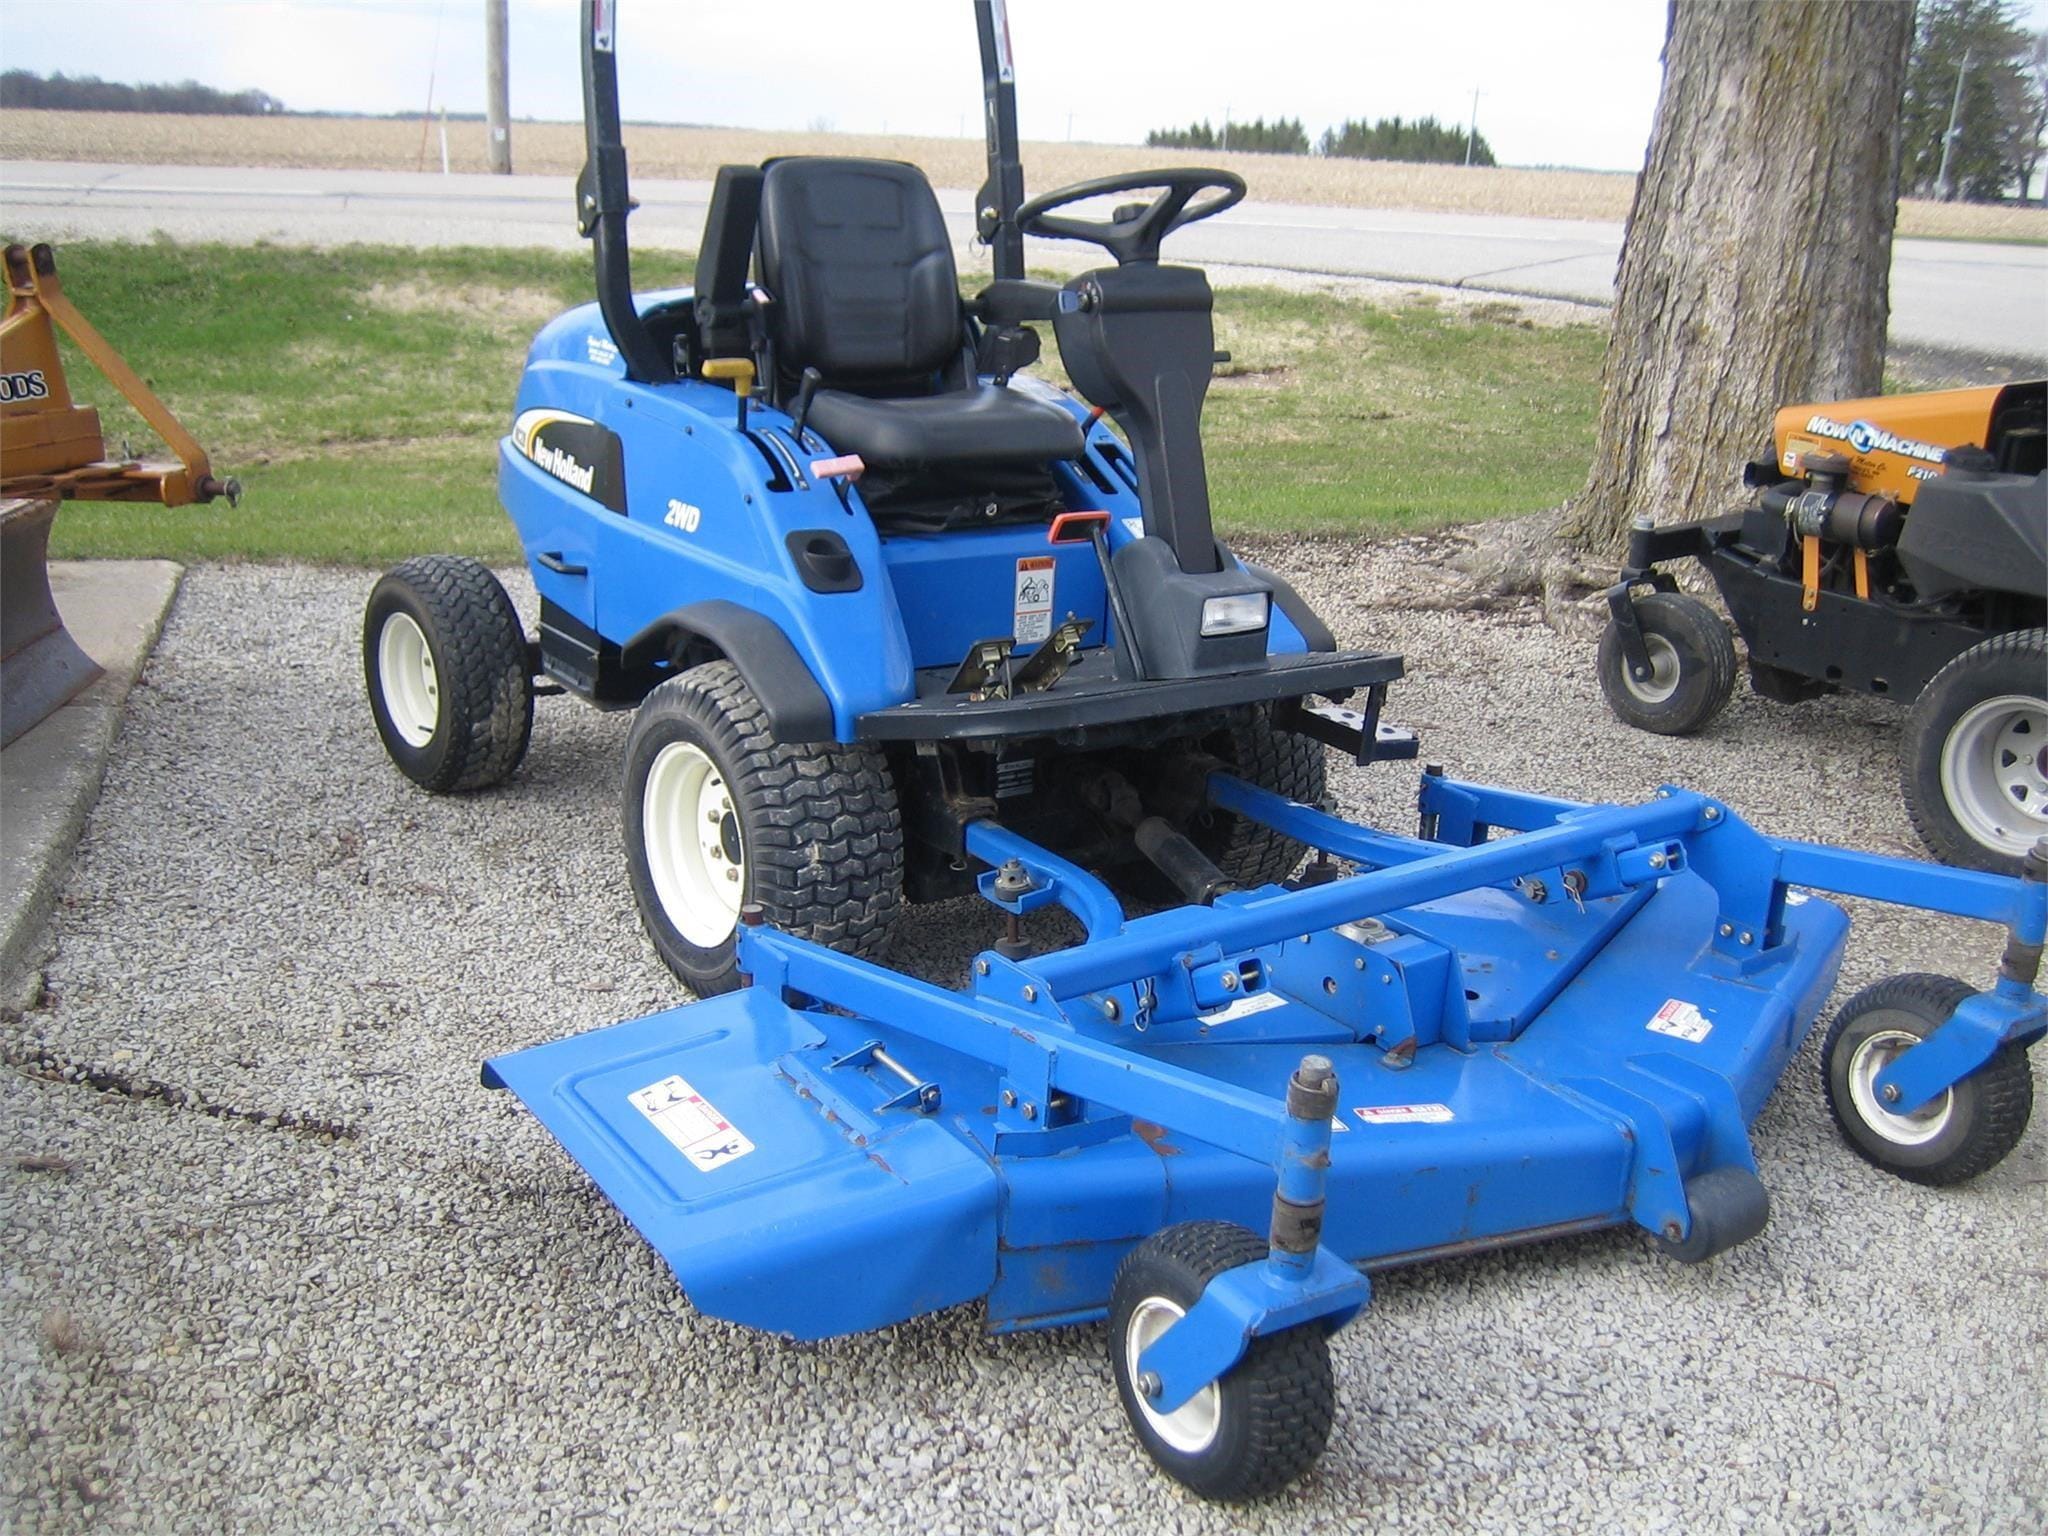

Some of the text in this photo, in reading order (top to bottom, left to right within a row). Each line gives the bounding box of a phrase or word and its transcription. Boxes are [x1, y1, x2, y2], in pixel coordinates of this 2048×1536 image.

[1866, 426, 1947, 462] MACHINE
[534, 436, 554, 472] New
[552, 448, 594, 494] Holland
[664, 498, 701, 533] 2WD
